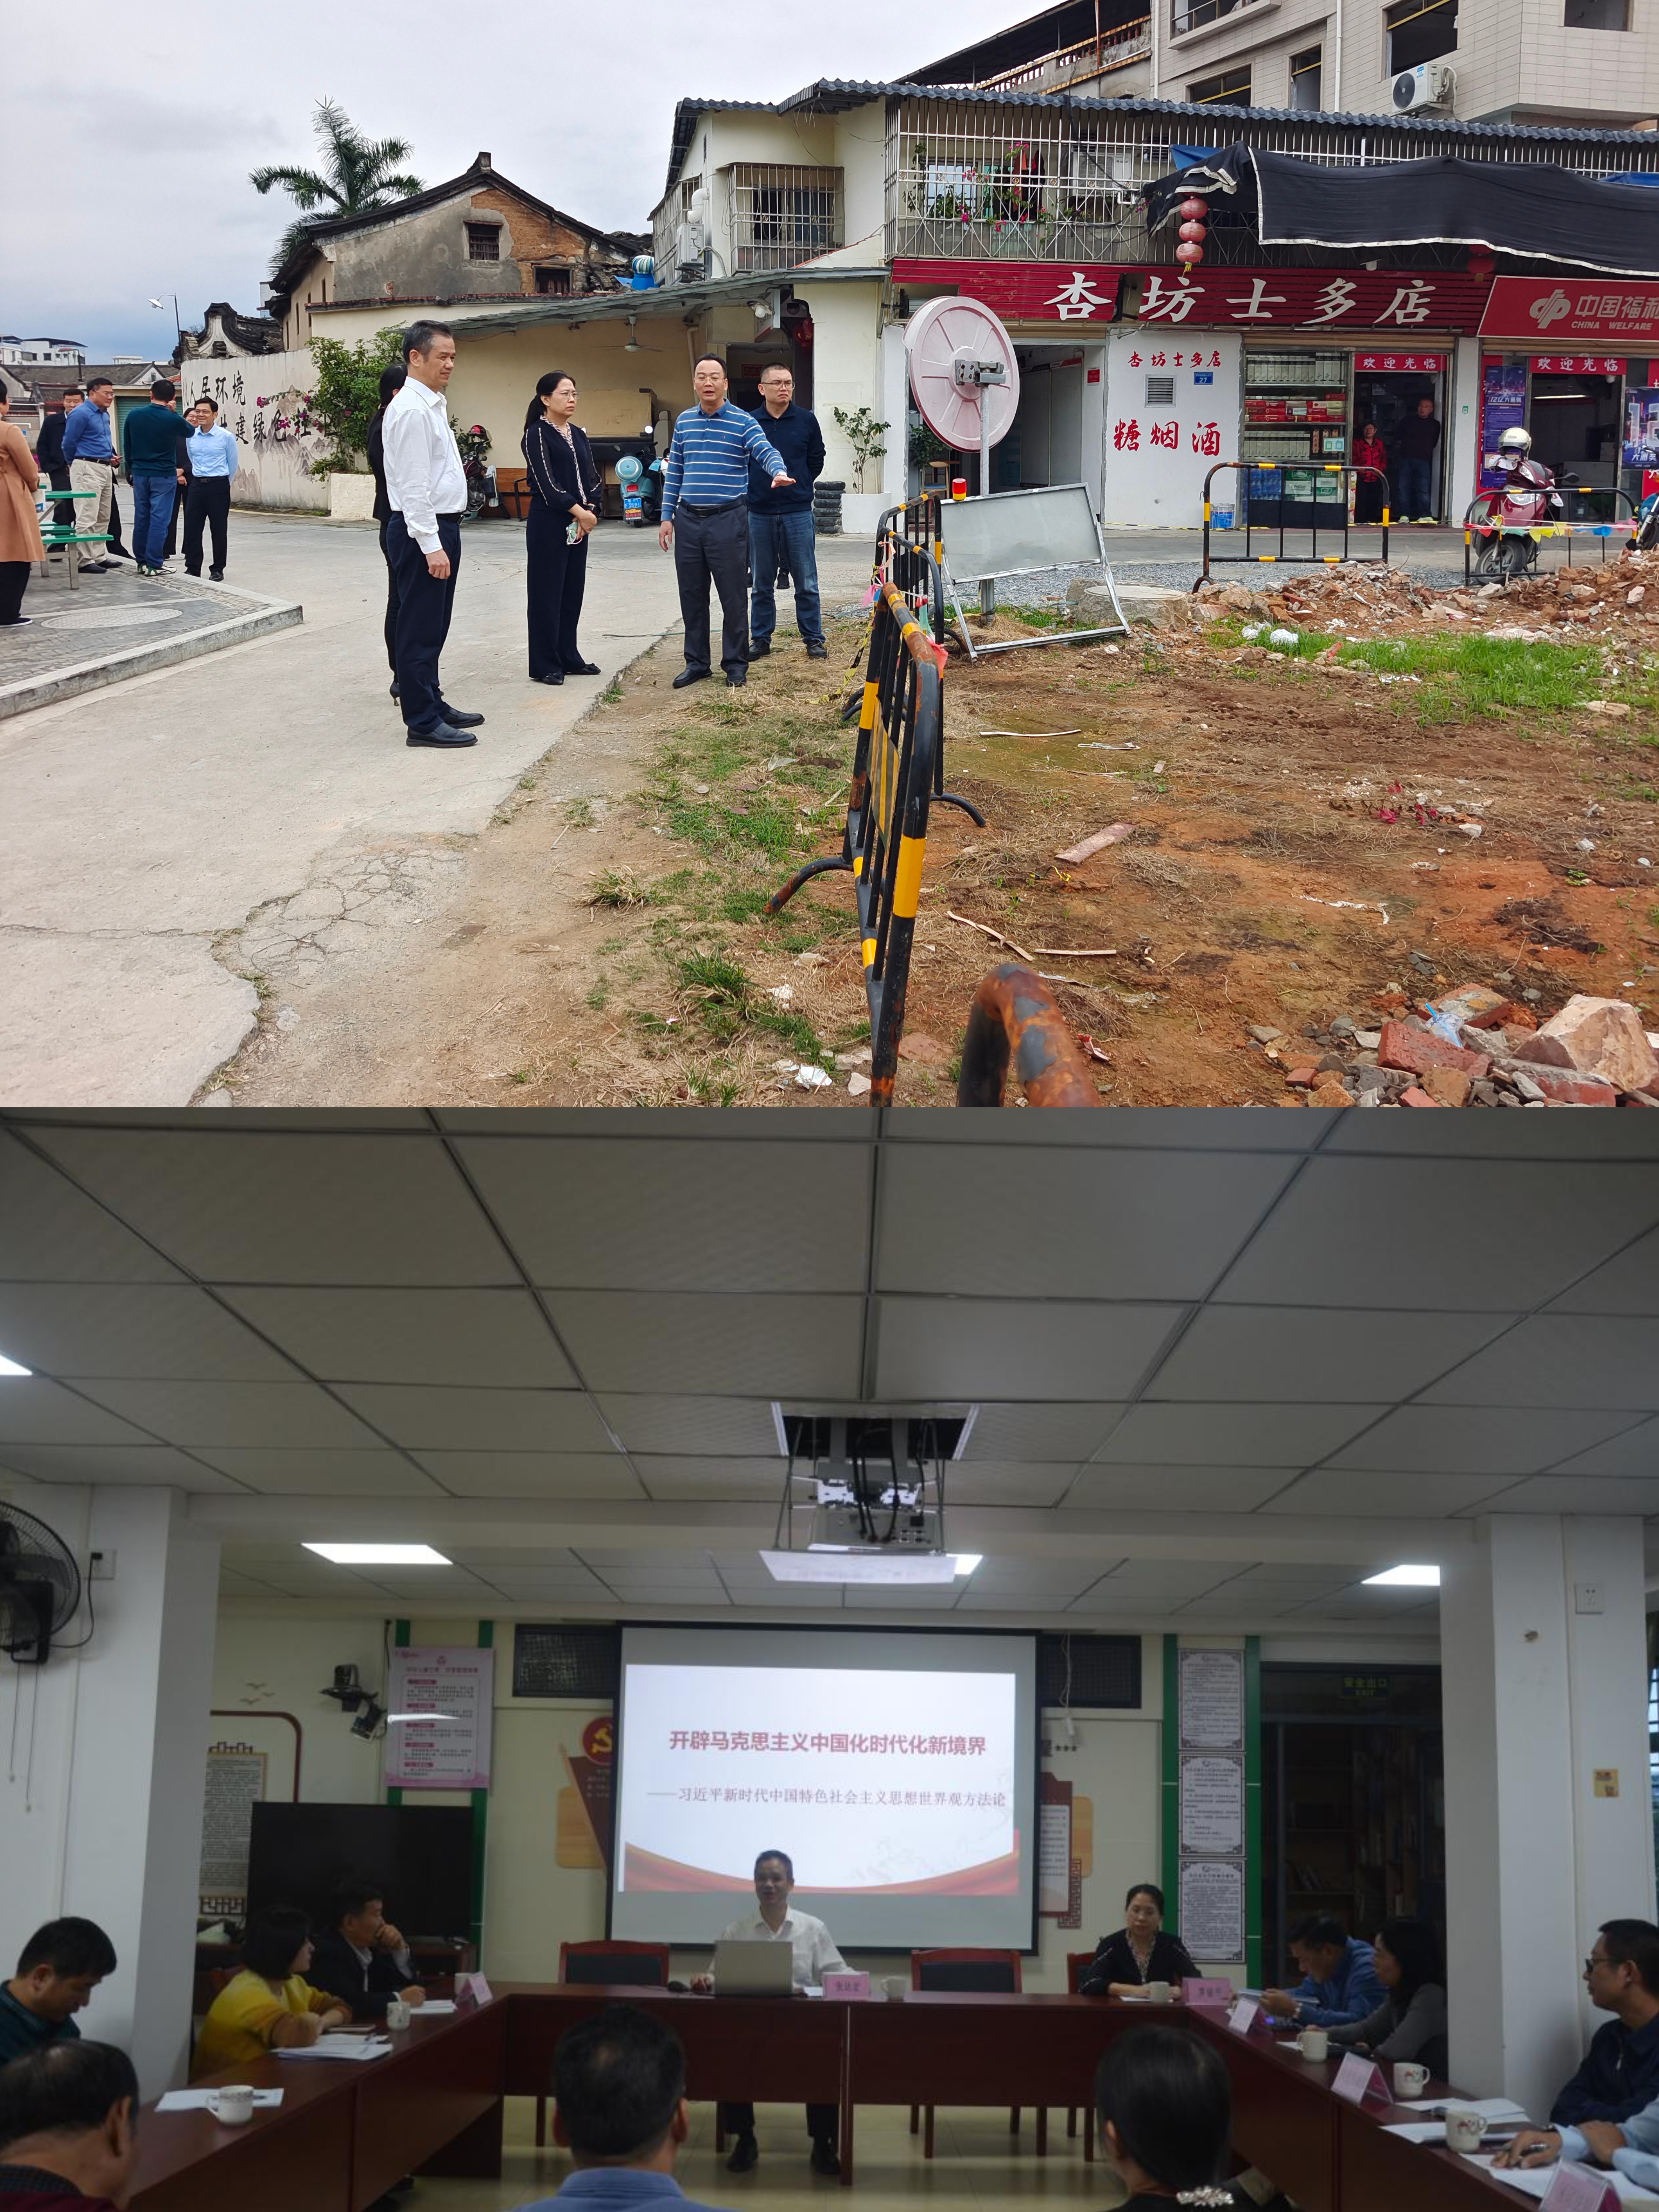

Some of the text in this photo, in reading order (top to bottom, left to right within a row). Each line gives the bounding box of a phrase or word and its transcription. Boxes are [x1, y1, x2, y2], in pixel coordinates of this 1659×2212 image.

[1043, 272, 1436, 324] 杏坊士多店
[1571, 321, 1653, 330] CHINA WELFARE
[1128, 350, 1221, 368] 杏坊士多店
[1363, 358, 1437, 369] 欢迎光临
[1537, 357, 1618, 372] 欢迎光临
[1113, 418, 1221, 456] 糖烟酒
[1343, 1676, 1386, 1688] 安全出口
[669, 1730, 986, 1756] 开辟马克思主义中国化时代化新境界
